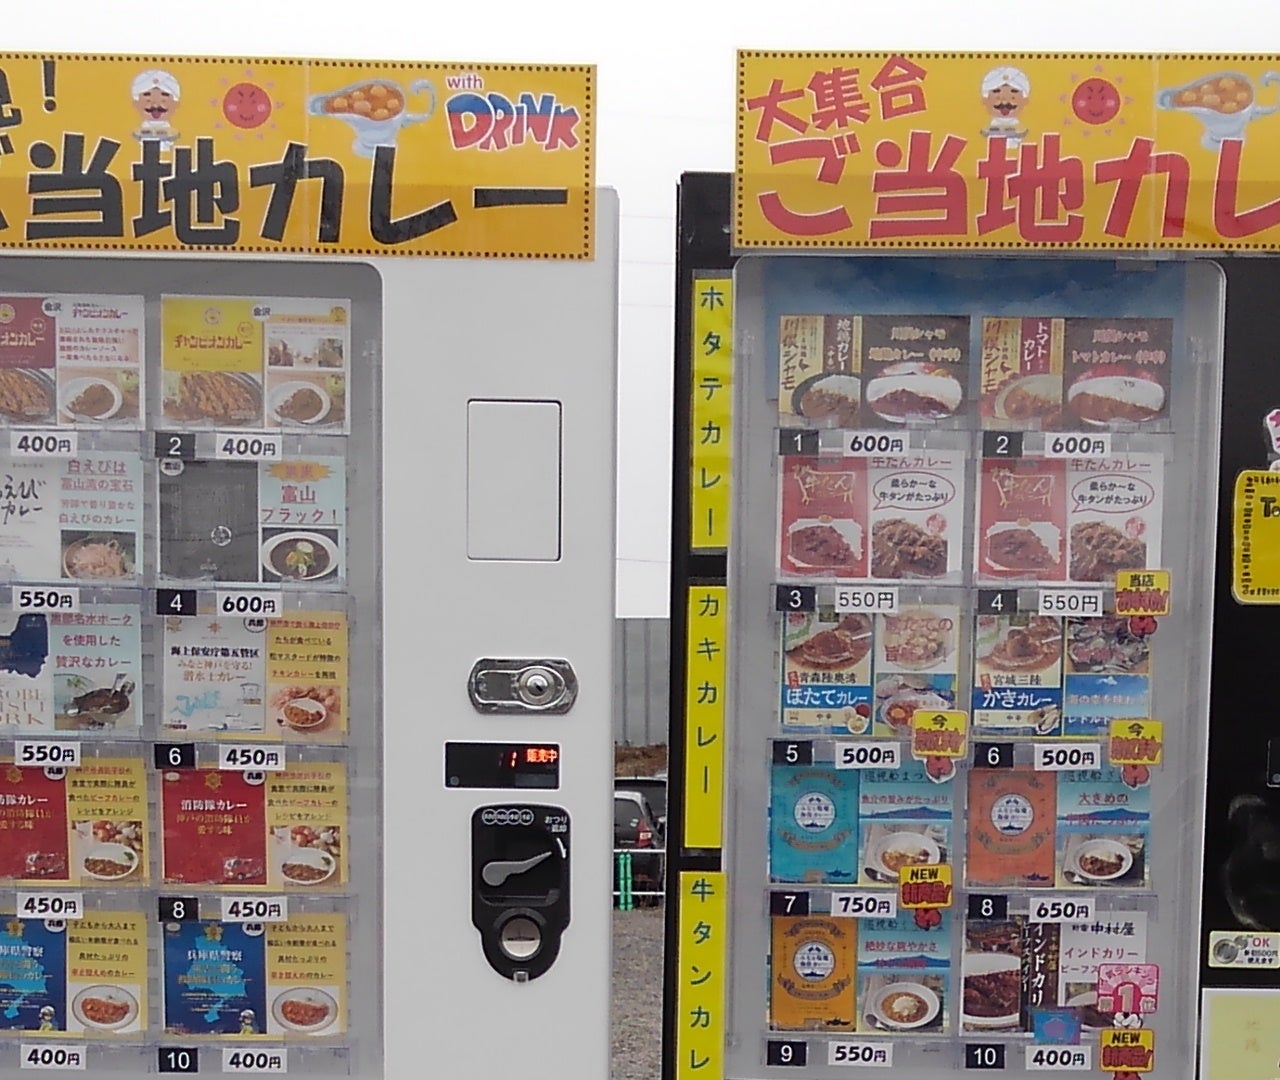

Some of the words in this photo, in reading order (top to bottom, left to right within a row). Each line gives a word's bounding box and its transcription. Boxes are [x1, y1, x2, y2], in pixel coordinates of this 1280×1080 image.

[447, 73, 483, 89] with
[747, 55, 926, 141] 大集合
[699, 286, 725, 536] ホタテカレー
[17, 436, 71, 452] 400円
[222, 438, 275, 456] 400円
[850, 436, 903, 452] 600円
[1052, 437, 1104, 454] 600円
[20, 591, 72, 608] 550円
[223, 596, 275, 613] 600円
[839, 592, 893, 609] 550円
[1043, 595, 1098, 612] 550円
[696, 595, 720, 793] カキカレー
[22, 745, 74, 762] 550円
[226, 749, 278, 765] 450円
[843, 747, 894, 764] 500円
[1042, 749, 1094, 766] 500円
[910, 867, 939, 881] NEW
[24, 897, 76, 913] 450円
[228, 901, 280, 917] 450円
[839, 897, 890, 913] 750円
[1037, 902, 1088, 918] 650円
[1252, 937, 1270, 948] OK
[1112, 1032, 1141, 1044] NEW
[28, 1049, 79, 1065] 400円
[229, 1053, 281, 1068] 400円
[835, 1046, 886, 1062] 550円
[1033, 1050, 1084, 1065] 400円
